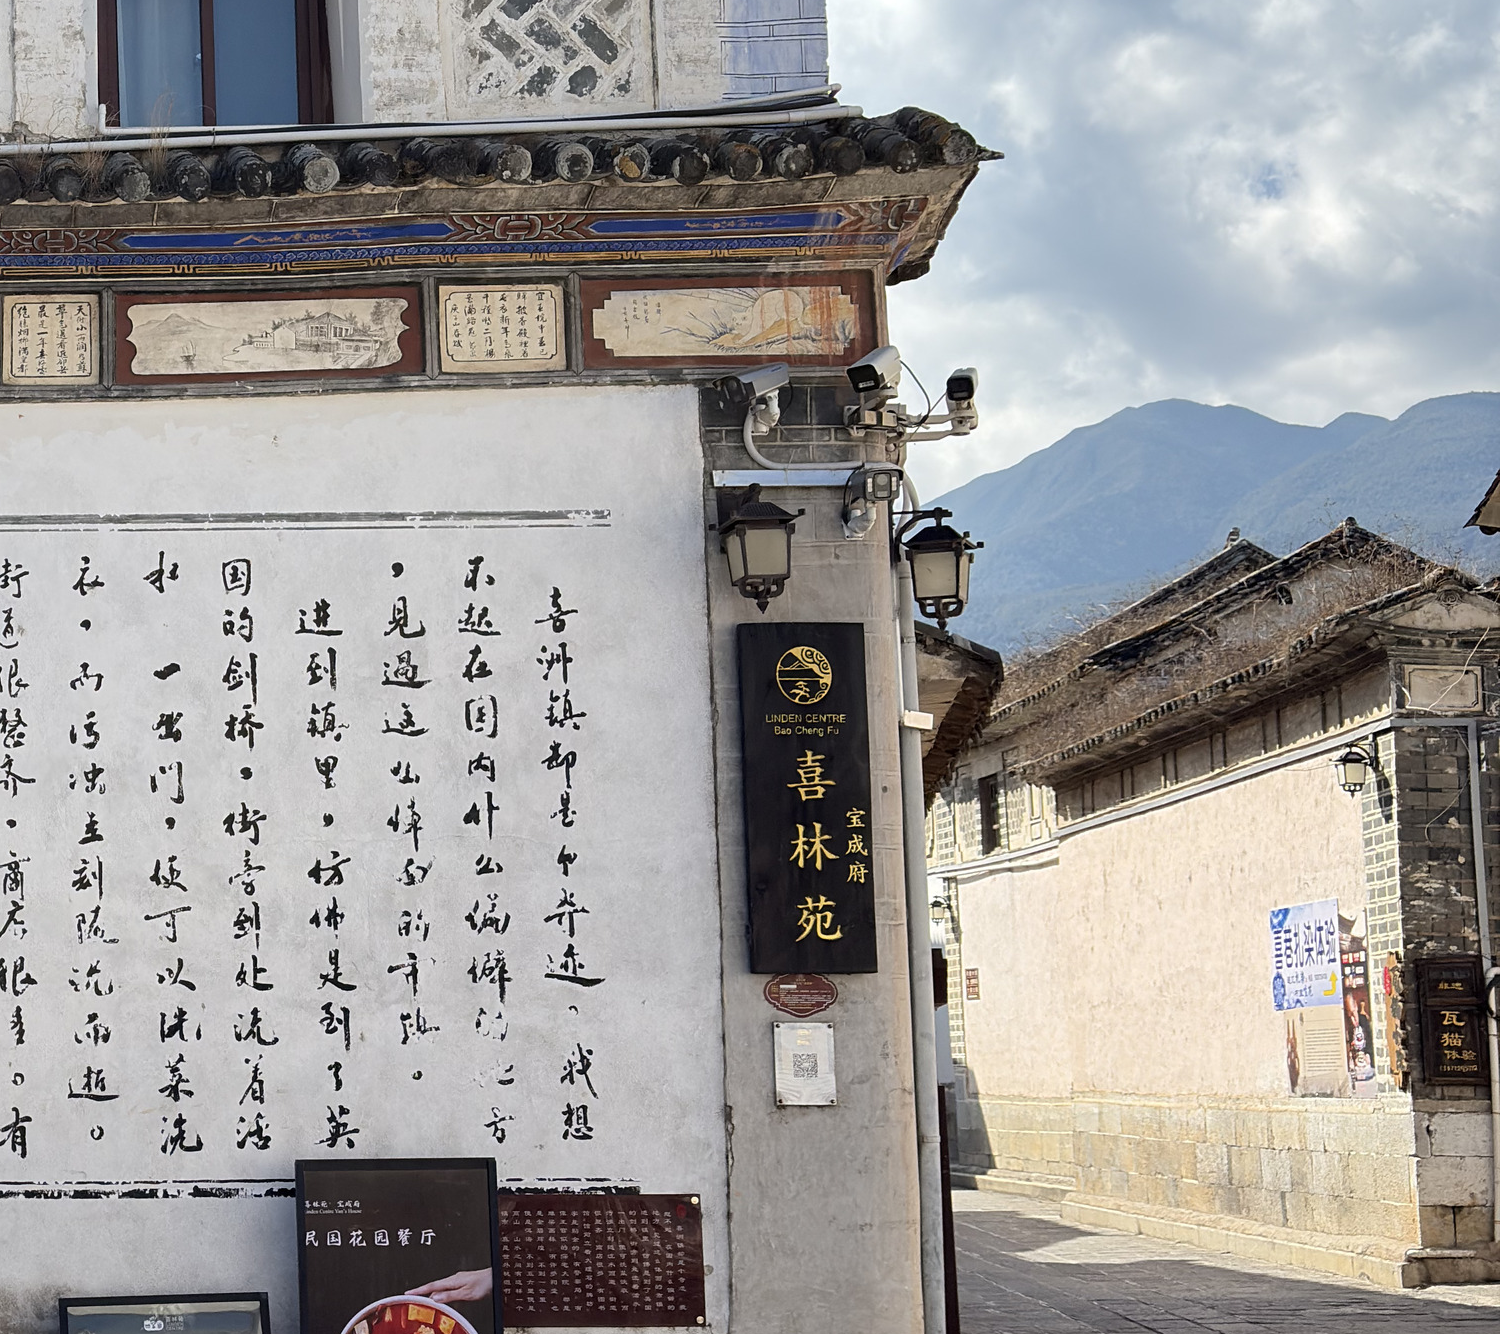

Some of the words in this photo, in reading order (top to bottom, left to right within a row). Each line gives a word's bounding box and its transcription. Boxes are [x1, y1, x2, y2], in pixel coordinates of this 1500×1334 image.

[765, 714, 802, 723] LINDEN
[805, 714, 847, 723] CENTRE
[774, 726, 792, 735] Bao
[795, 726, 824, 737] Cheng
[827, 726, 840, 735] Fu
[786, 749, 843, 942] 喜林苑
[845, 807, 869, 884] 宝成府
[1440, 1011, 1466, 1047] 瓦猫
[1444, 1050, 1477, 1061] 体验
[305, 1228, 436, 1247] 民国花园餐厅
